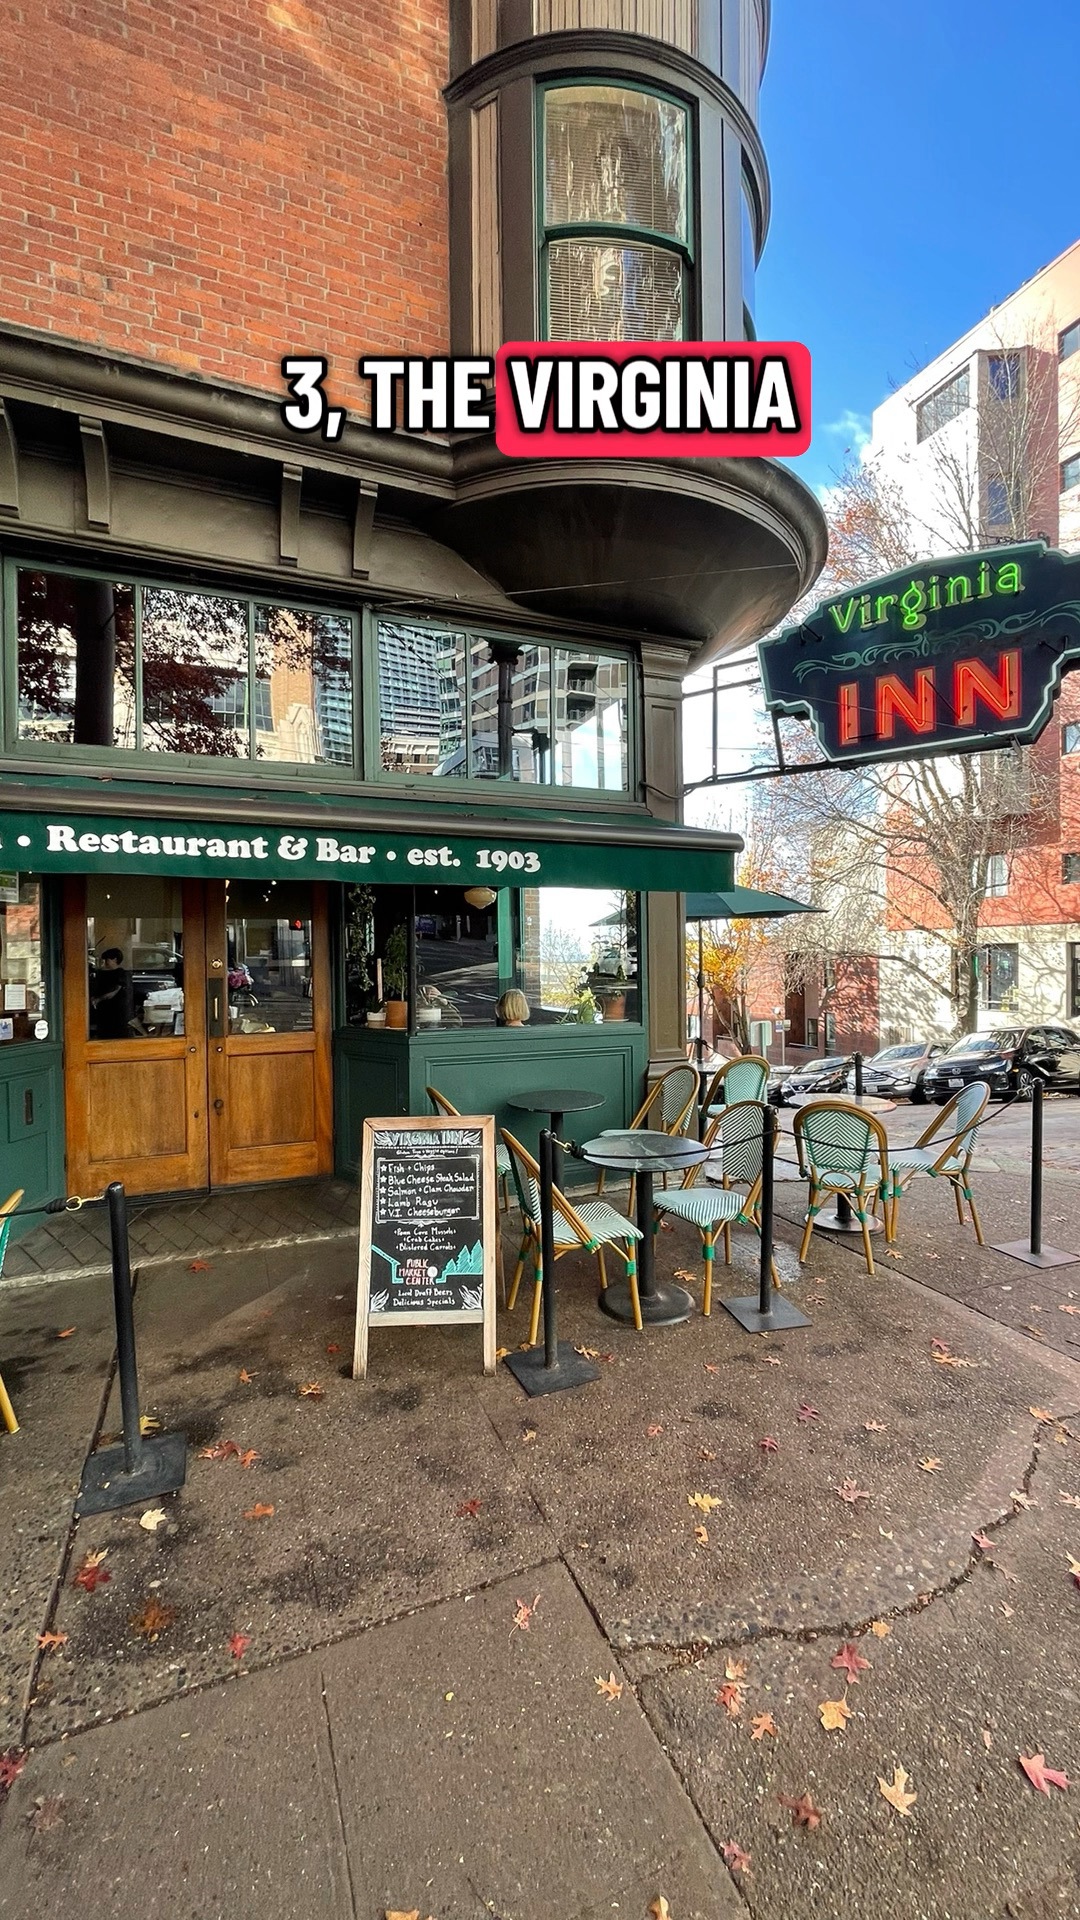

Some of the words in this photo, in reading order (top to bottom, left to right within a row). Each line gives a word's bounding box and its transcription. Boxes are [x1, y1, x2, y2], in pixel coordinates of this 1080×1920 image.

[827, 561, 1026, 633] Virginia
[838, 648, 1023, 747] INN
[46, 824, 269, 859] Restaurant
[277, 835, 309, 860] &
[315, 838, 376, 864] Bar
[407, 846, 461, 867] est.
[476, 849, 541, 873] 1903
[413, 1162, 435, 1174] Chips
[388, 1175, 406, 1185] Blue
[406, 1174, 435, 1185] Cheese
[454, 1172, 475, 1182] Salad
[387, 1186, 417, 1197] Salmon
[423, 1185, 443, 1194] Clam
[388, 1197, 411, 1208] Lamb
[415, 1196, 439, 1208] Ragu
[407, 1206, 460, 1217] Cheeseburger
[406, 1258, 429, 1269] PUBLIC
[398, 1268, 426, 1277] MARKET
[405, 1276, 435, 1286] CENTER
